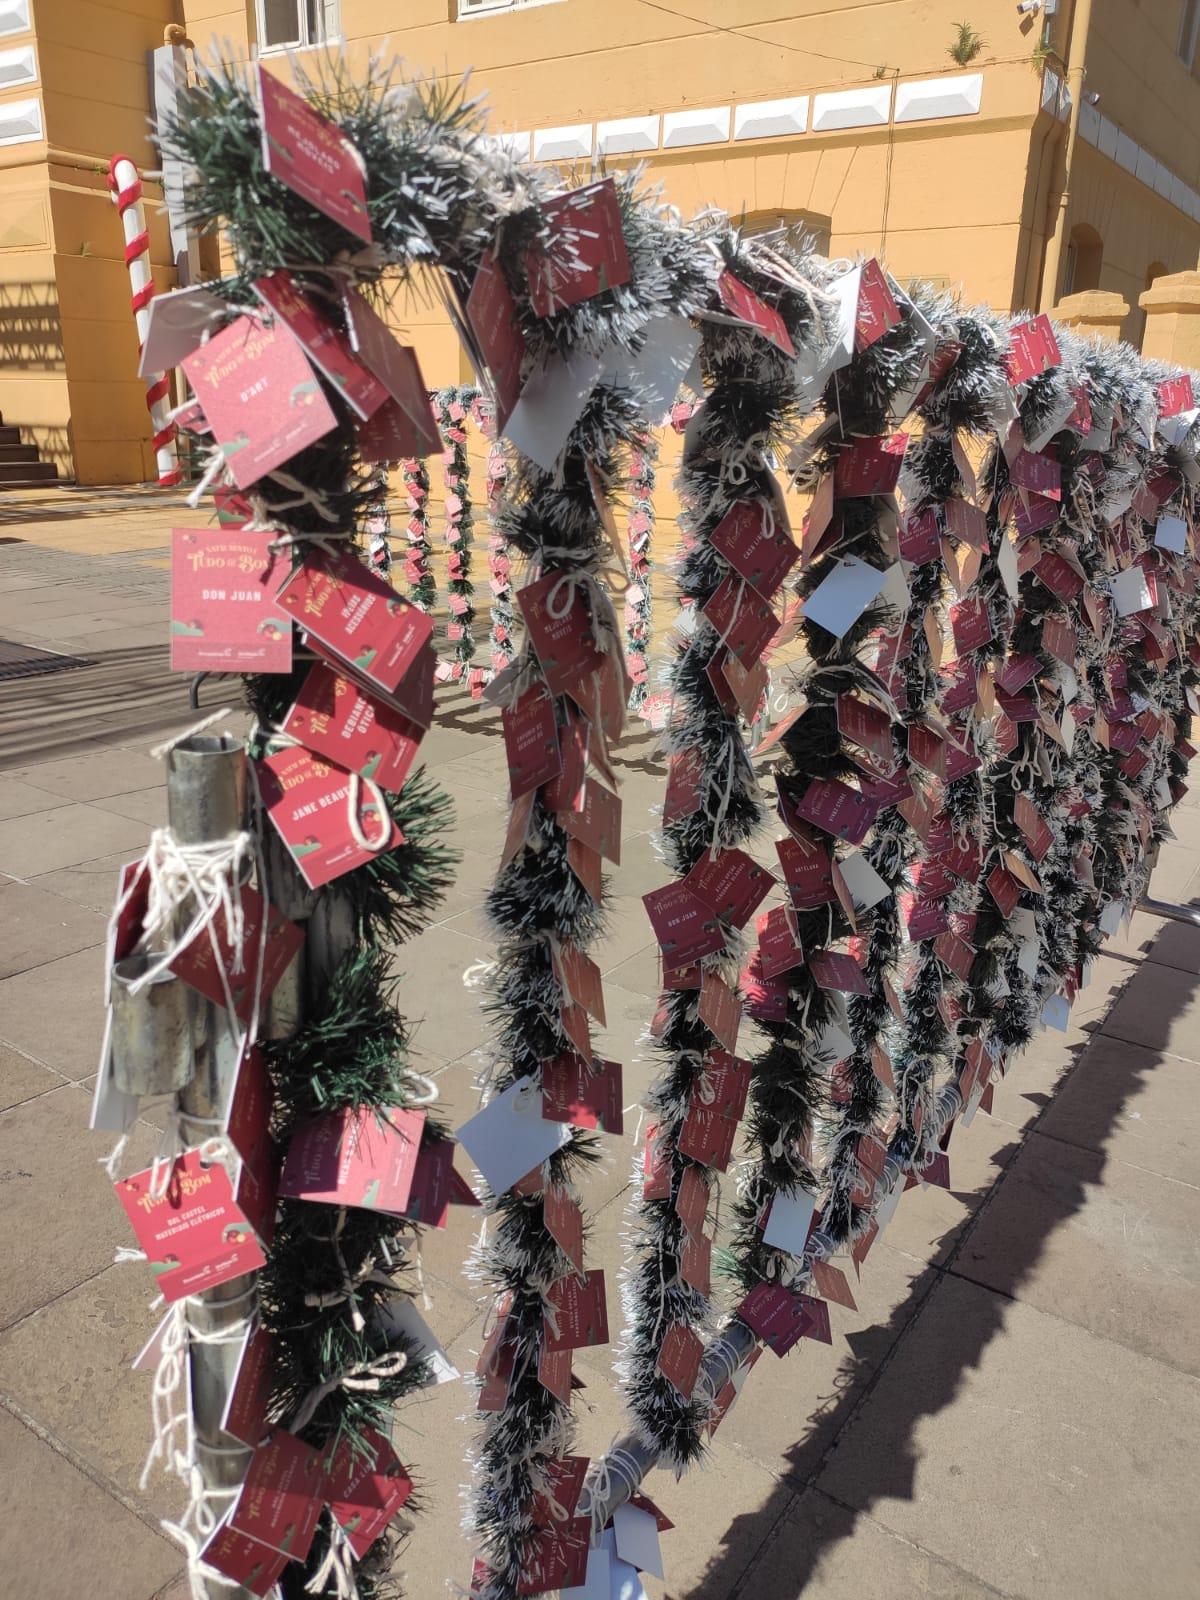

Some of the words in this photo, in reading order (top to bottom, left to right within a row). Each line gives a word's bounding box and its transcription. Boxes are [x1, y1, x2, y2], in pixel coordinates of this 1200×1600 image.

[202, 590, 225, 600] DON
[231, 591, 261, 601] JUAN
[291, 802, 317, 820] JANE
[318, 785, 351, 807] BEAUT
[179, 1174, 210, 1196] BOM
